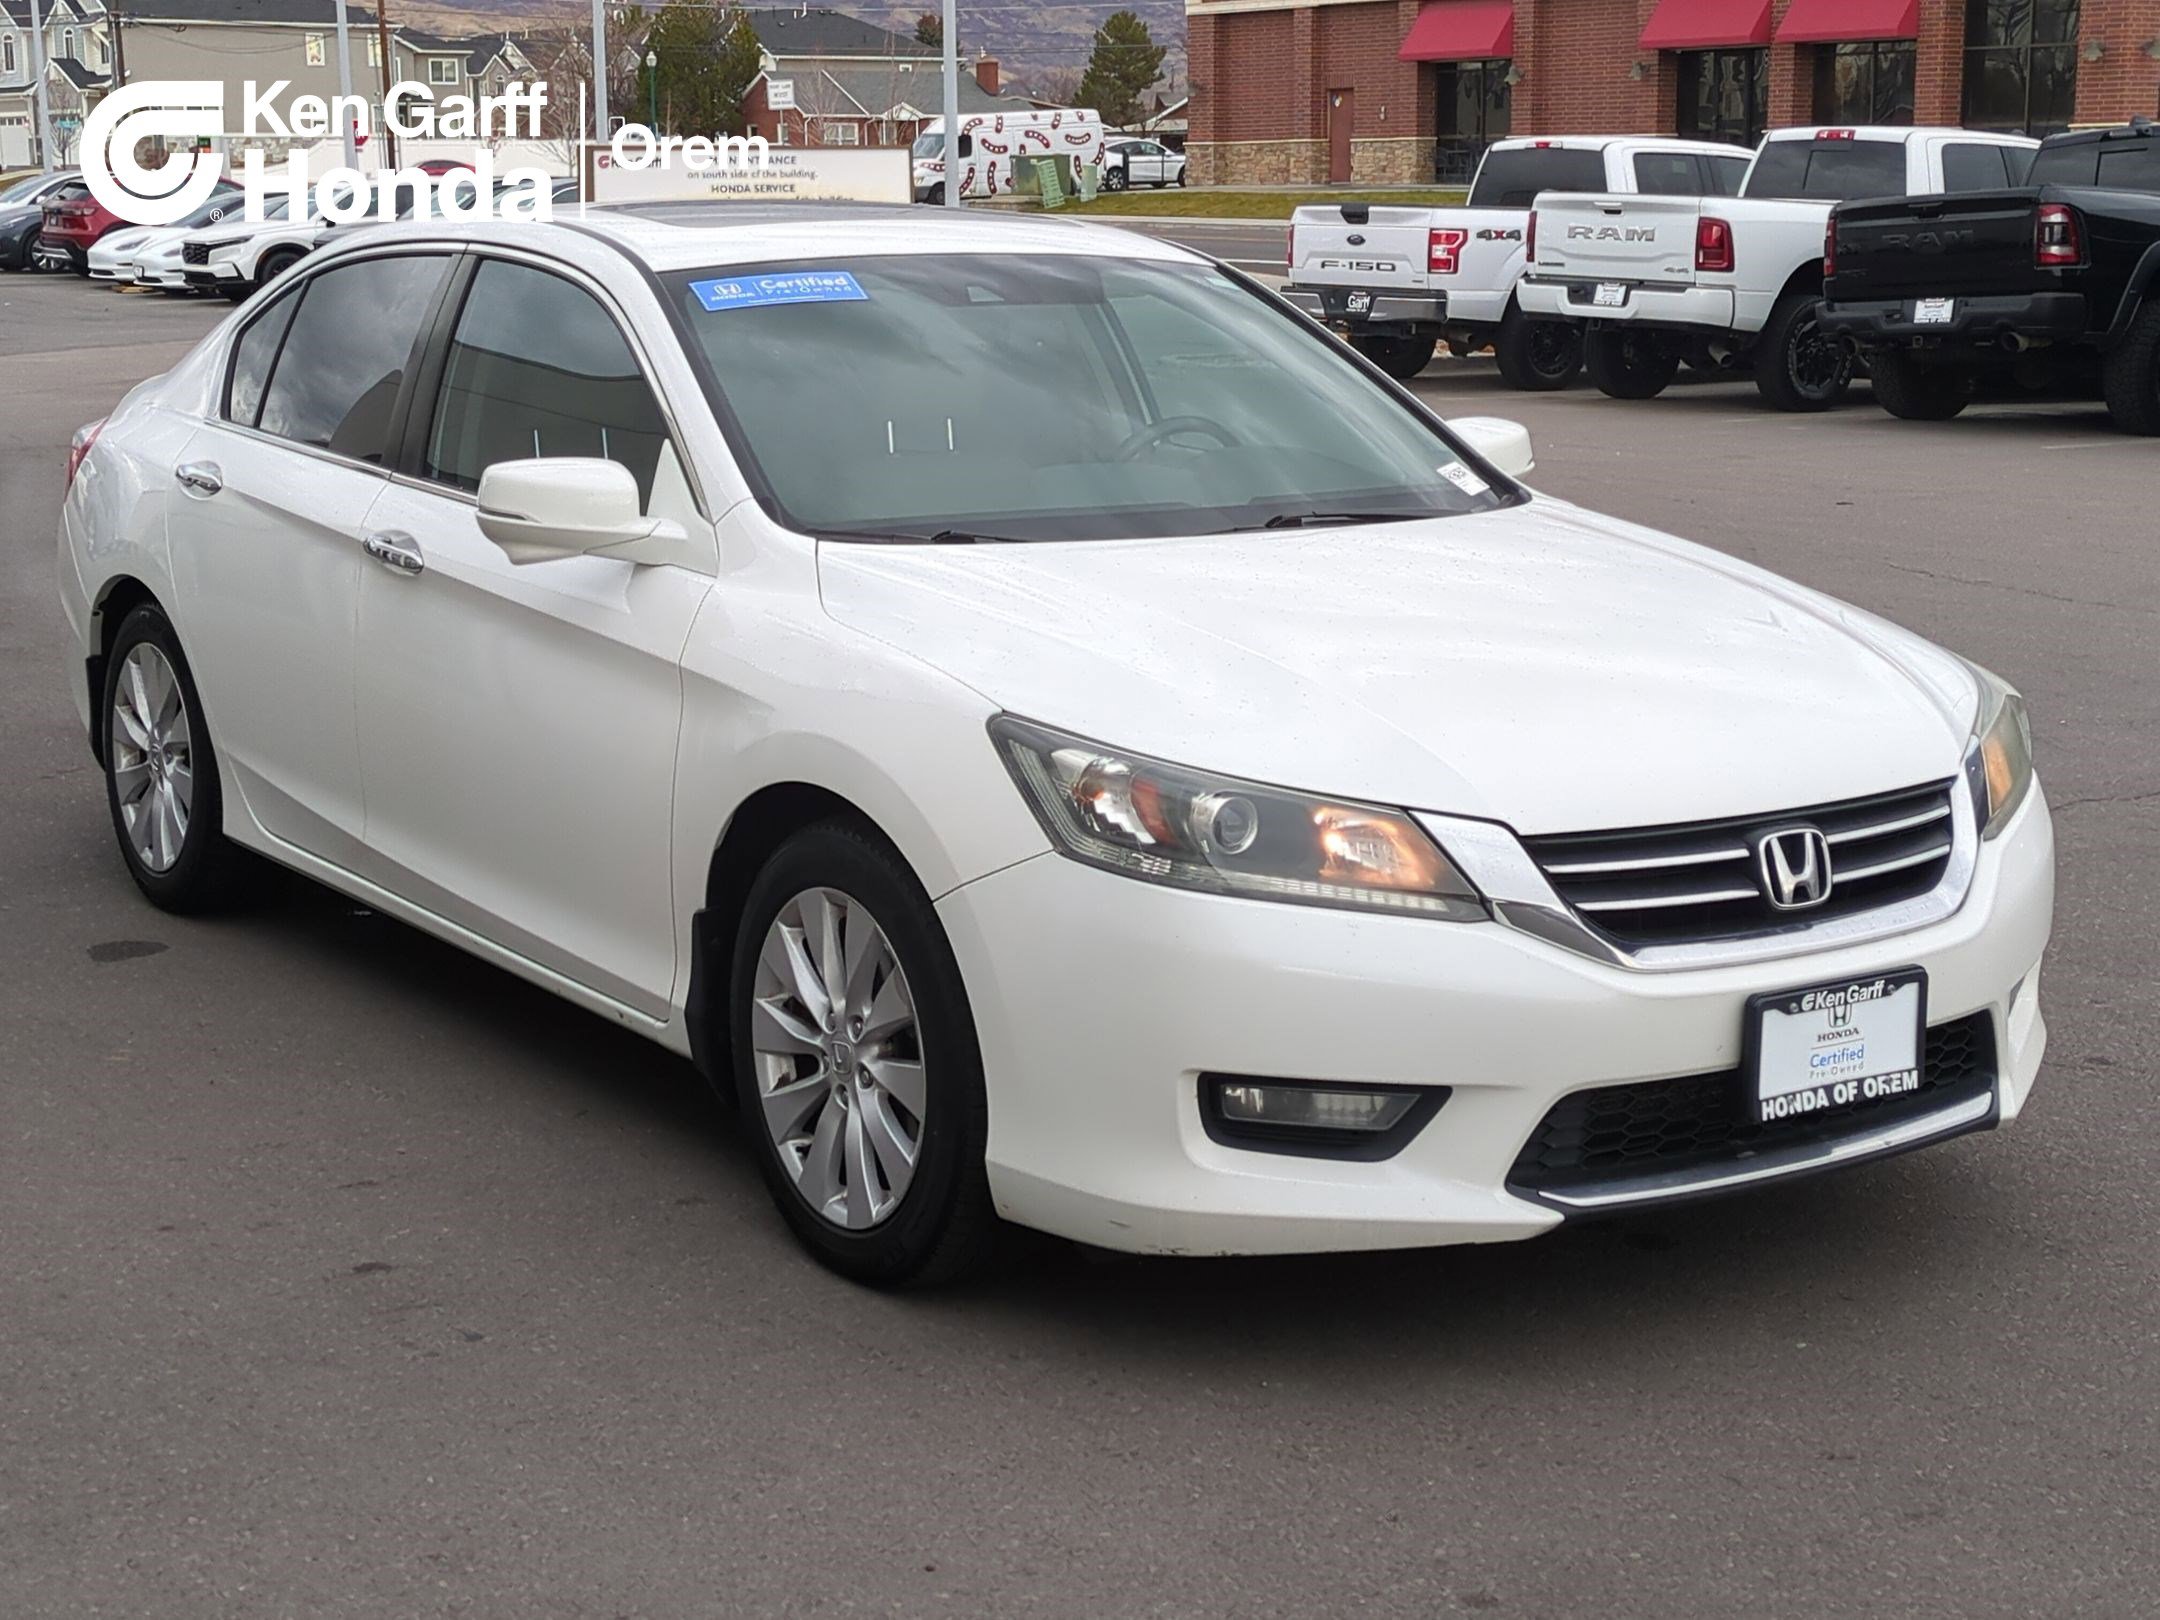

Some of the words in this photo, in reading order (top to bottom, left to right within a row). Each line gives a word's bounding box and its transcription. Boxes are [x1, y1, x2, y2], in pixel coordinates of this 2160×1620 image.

[687, 171, 699, 179] on
[702, 169, 727, 179] south
[730, 169, 748, 179] side
[762, 169, 777, 178] the
[780, 169, 818, 180] building.
[711, 184, 751, 193] HONDA
[754, 184, 796, 193] SERVICE
[1567, 225, 1656, 242] RAM
[1881, 230, 1973, 250] RAM
[1321, 261, 1396, 271] F-150
[760, 276, 848, 290] Certified
[1815, 990, 1845, 1010] Ken
[1846, 979, 1885, 1003] Garff
[1817, 1027, 1859, 1042] HONDA
[1810, 1044, 1864, 1068] Certified
[1762, 1087, 1829, 1121] HONDA
[1833, 1081, 1858, 1104] OF
[1863, 1069, 1919, 1098] OREM
